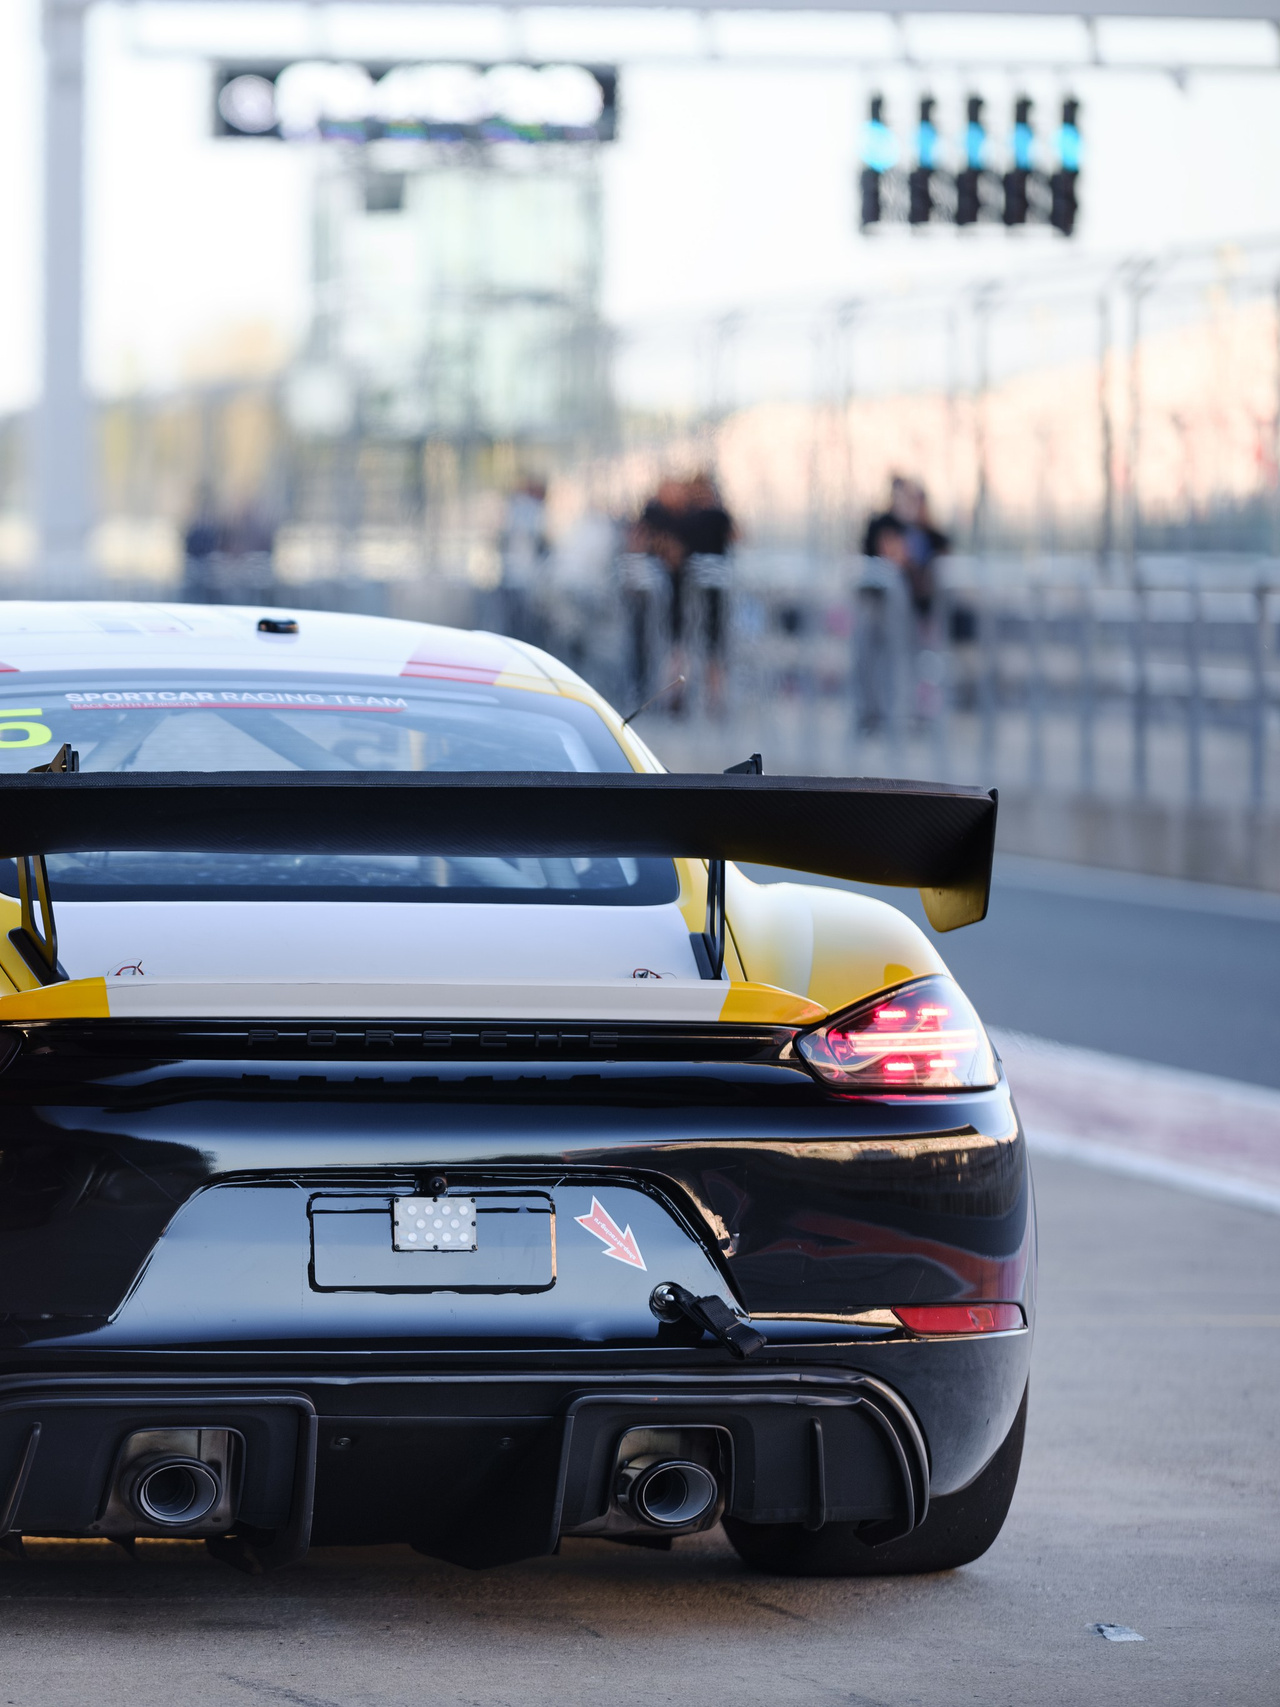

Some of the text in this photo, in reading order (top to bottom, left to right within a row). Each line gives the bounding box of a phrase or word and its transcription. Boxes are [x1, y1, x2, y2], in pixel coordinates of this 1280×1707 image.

[64, 691, 408, 708] SPORTCAR RACING TEAM
[248, 1029, 619, 1047] PORSCHE
